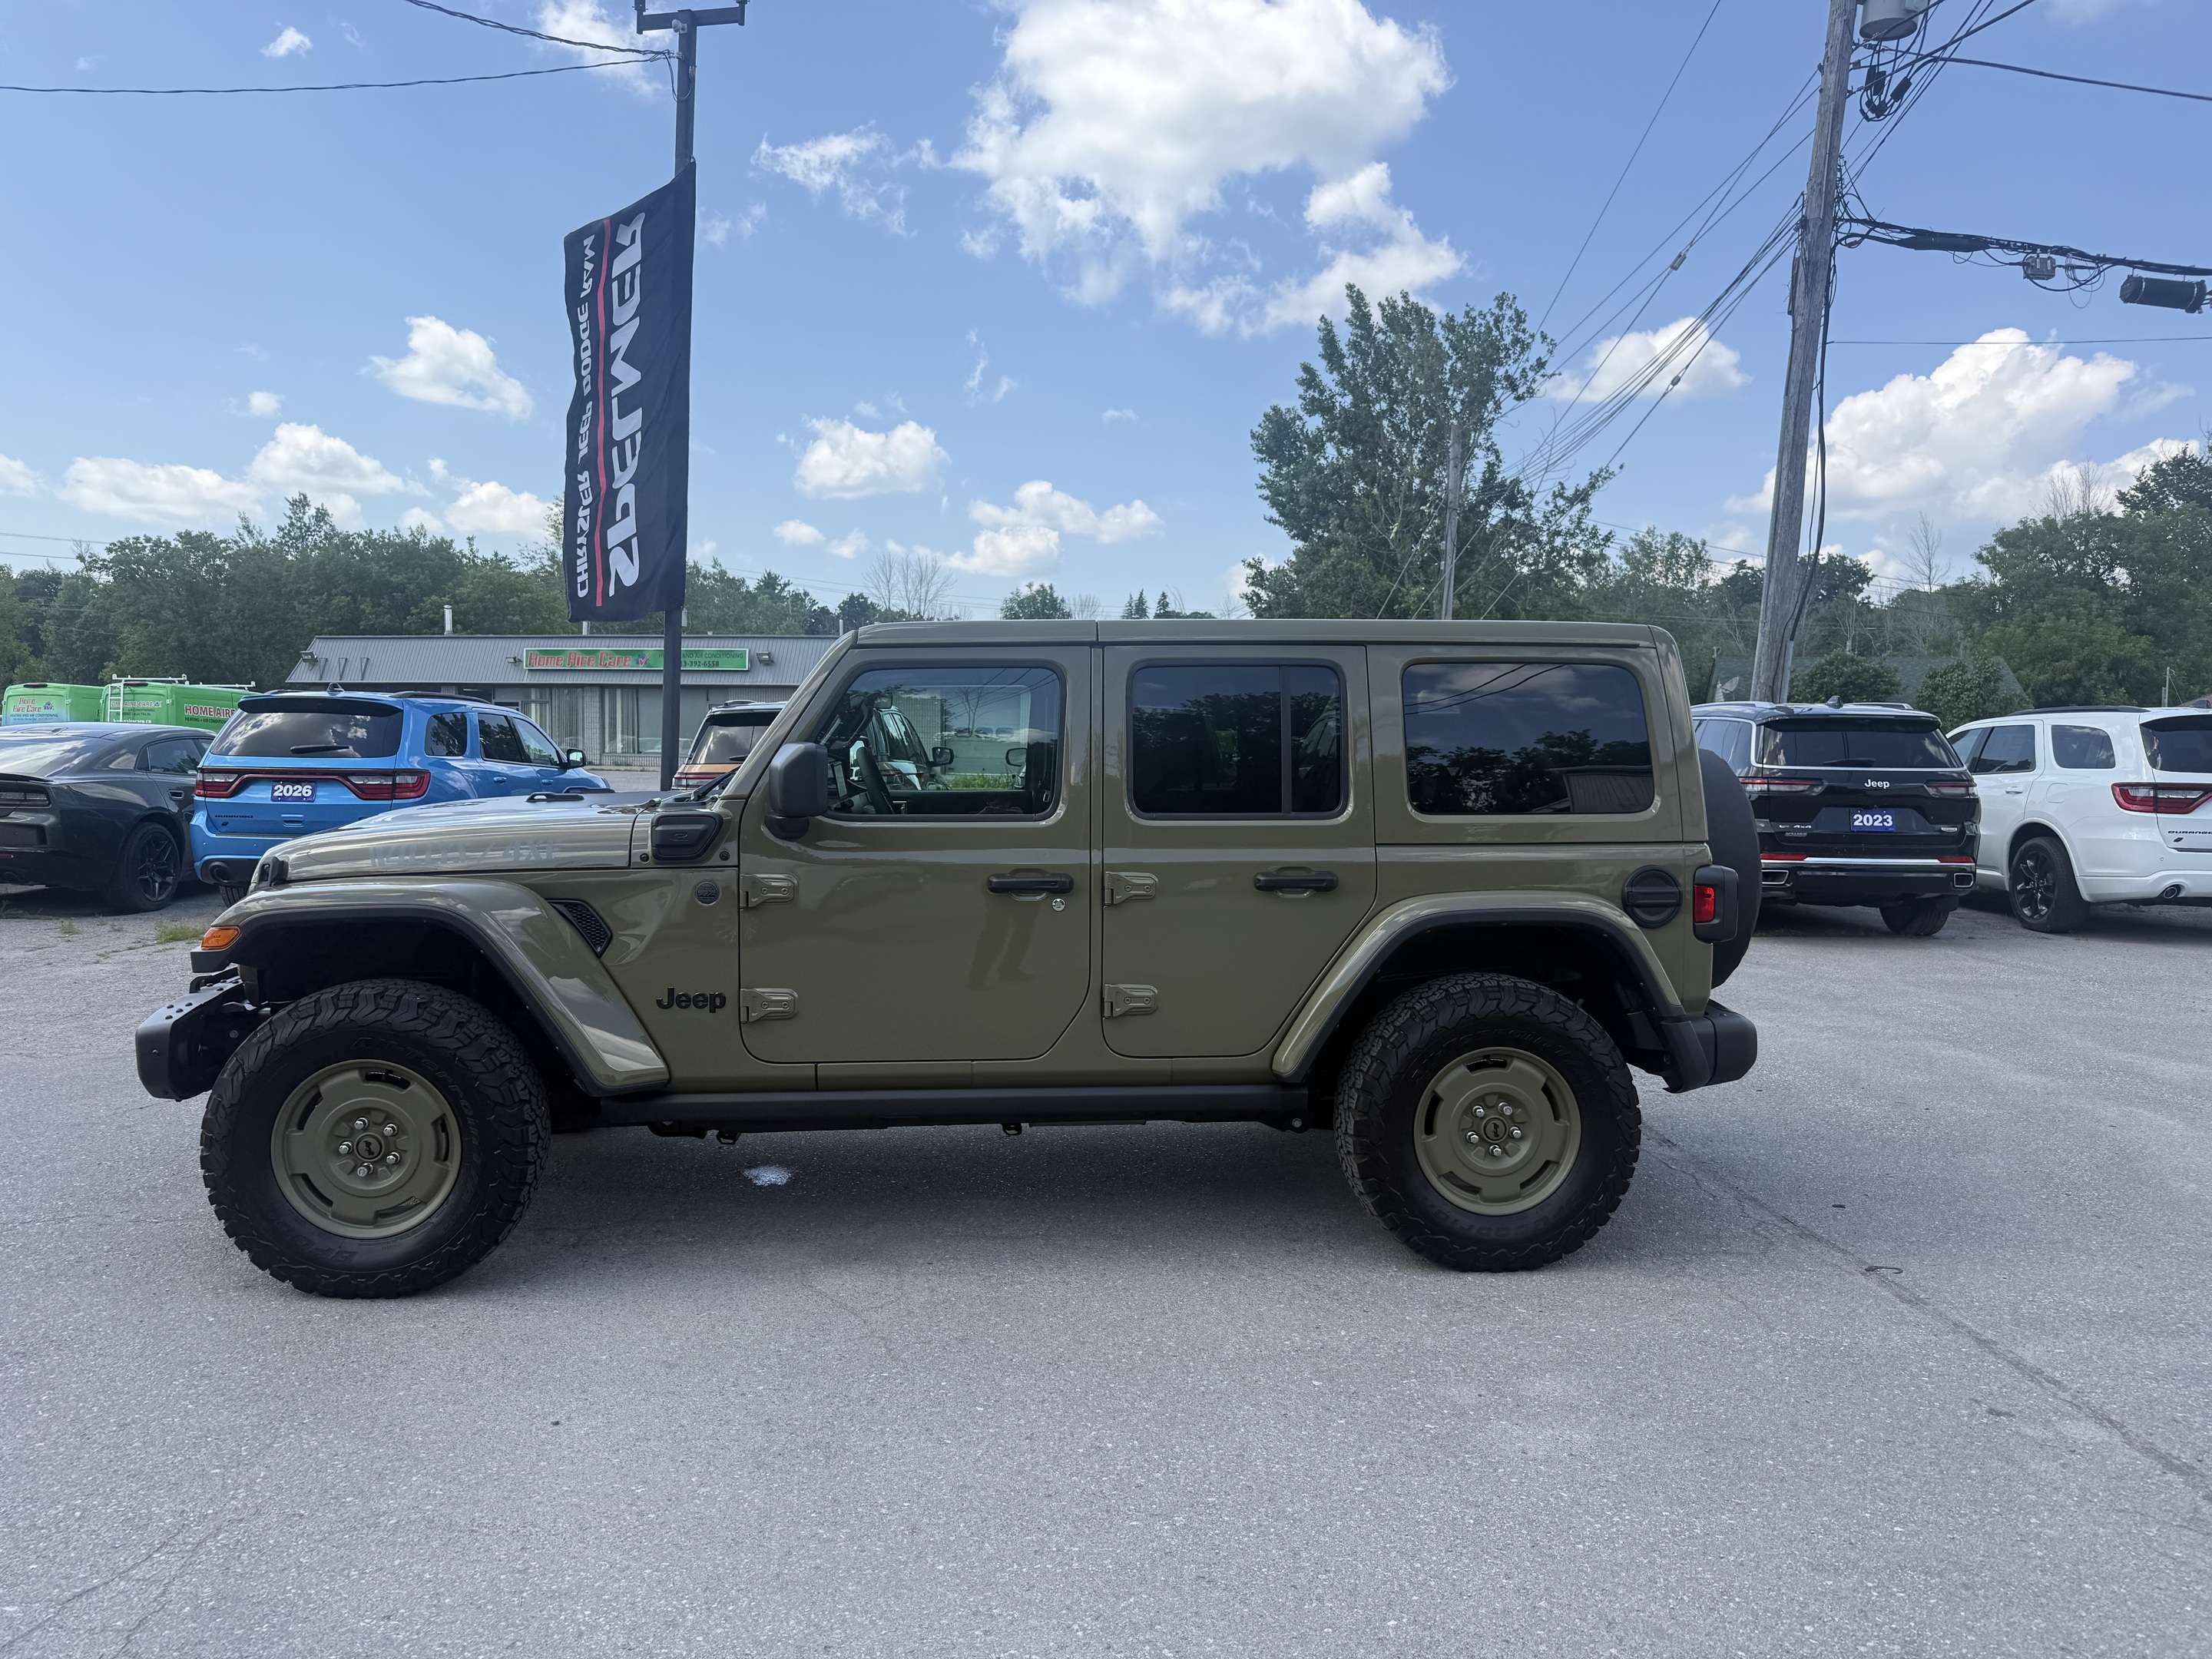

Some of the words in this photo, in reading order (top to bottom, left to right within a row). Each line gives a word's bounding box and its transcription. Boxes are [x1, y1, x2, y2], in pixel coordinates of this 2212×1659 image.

[528, 651, 564, 667] Home
[599, 651, 631, 667] Care
[184, 704, 214, 717] HOME
[273, 784, 313, 796] 2026
[1864, 779, 1890, 790] Jeep
[1853, 814, 1893, 826] 2023
[656, 986, 727, 1013] Jeep
